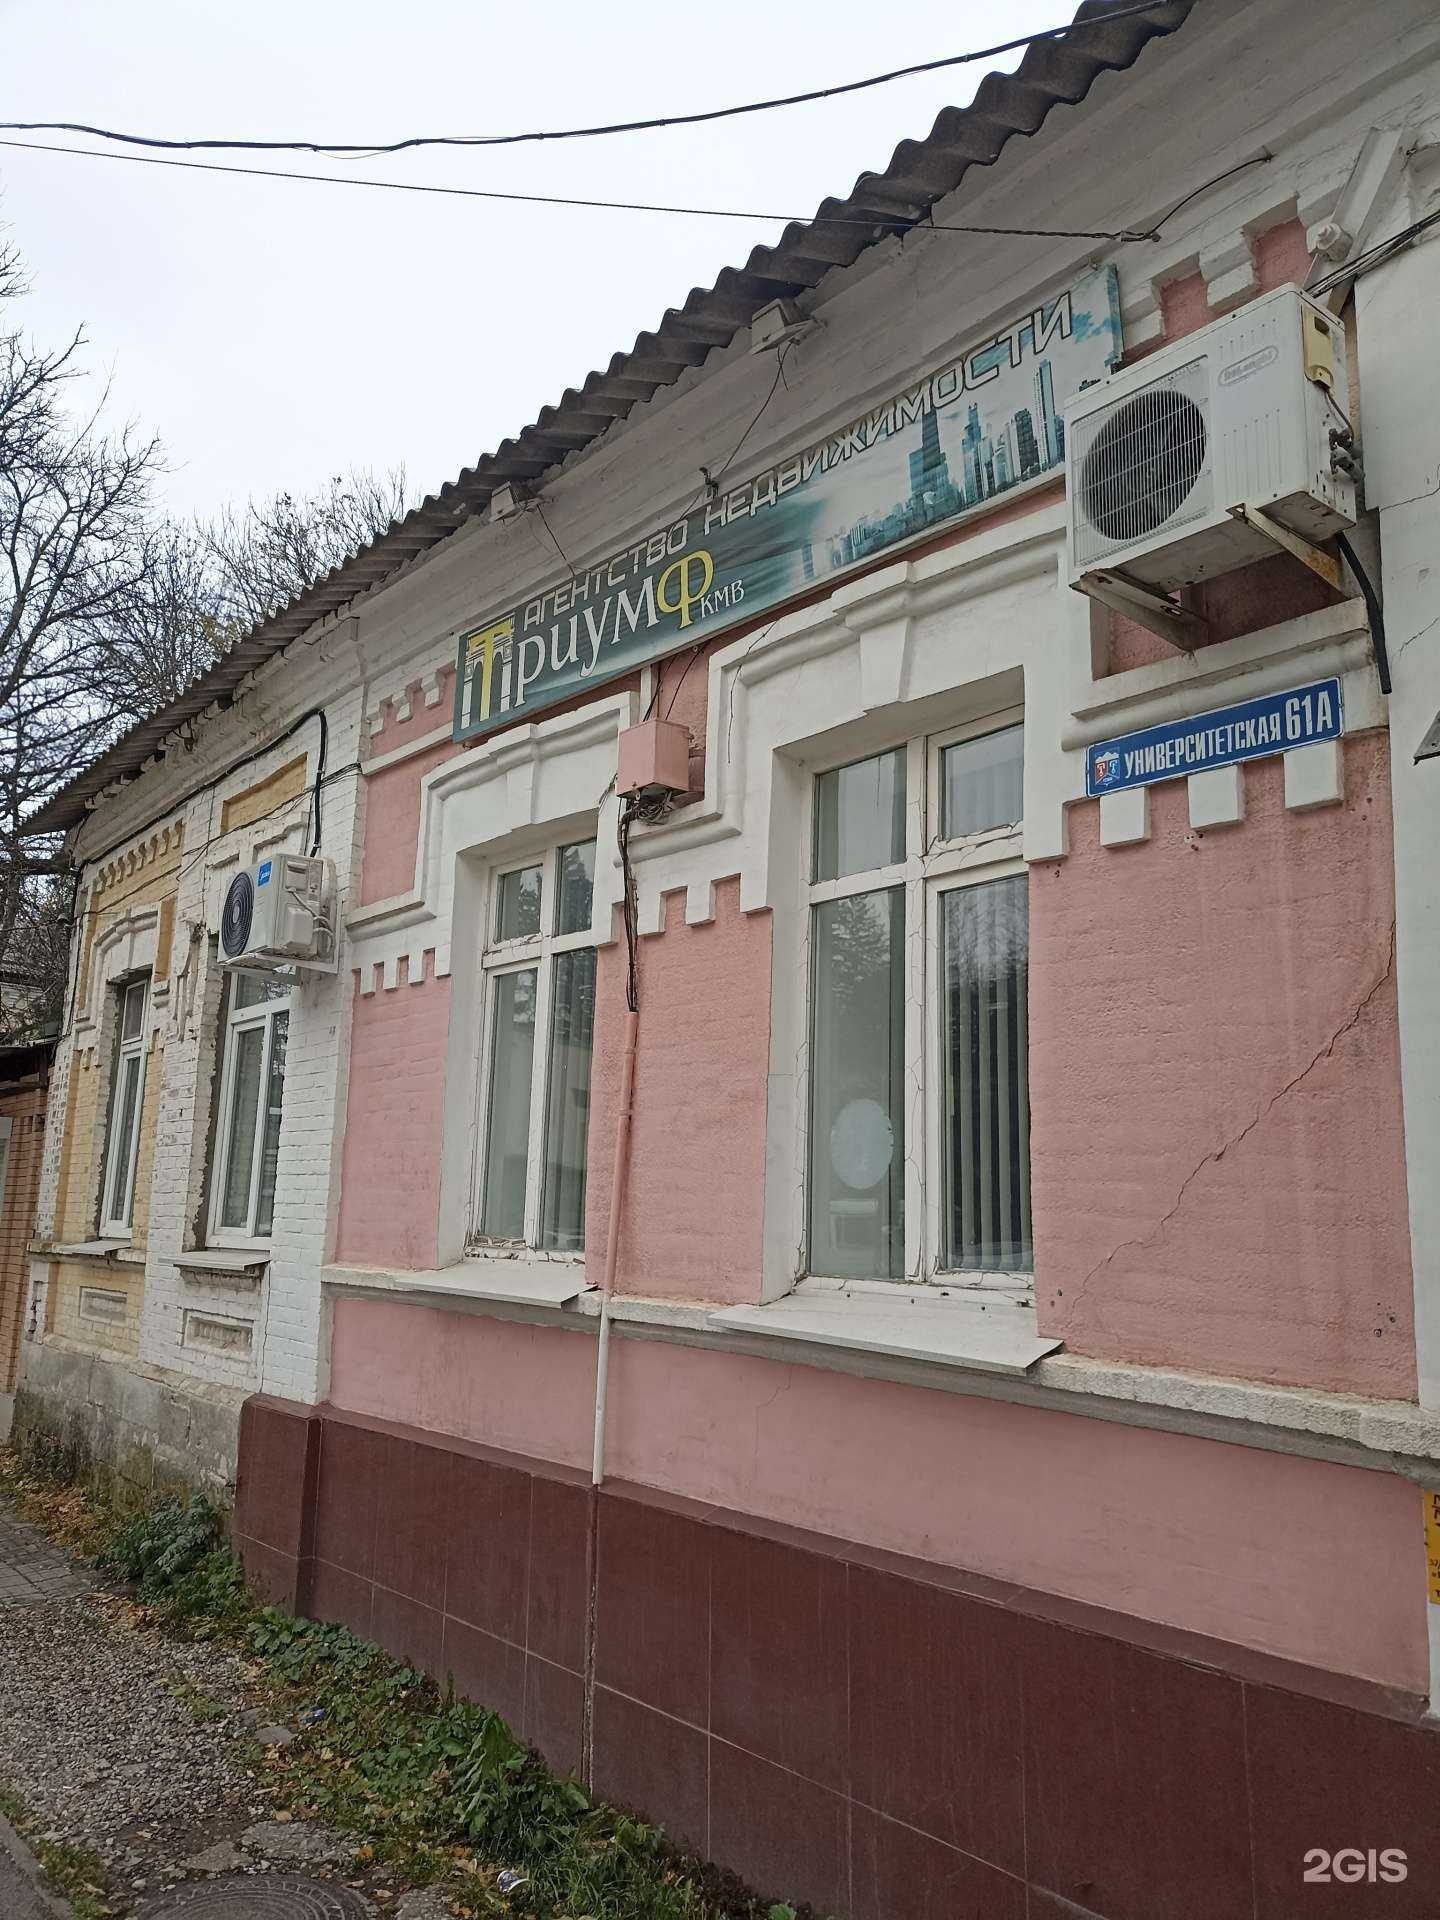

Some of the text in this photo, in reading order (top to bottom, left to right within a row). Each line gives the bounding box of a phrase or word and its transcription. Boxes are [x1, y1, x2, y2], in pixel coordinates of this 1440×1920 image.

[523, 290, 1073, 632] АГЕНТСТВО НЕДВИЖИМОСТИ
[701, 579, 745, 619] КМВ
[1124, 690, 1333, 779] УНИВЕРСИТЕТСКАЯ 61А
